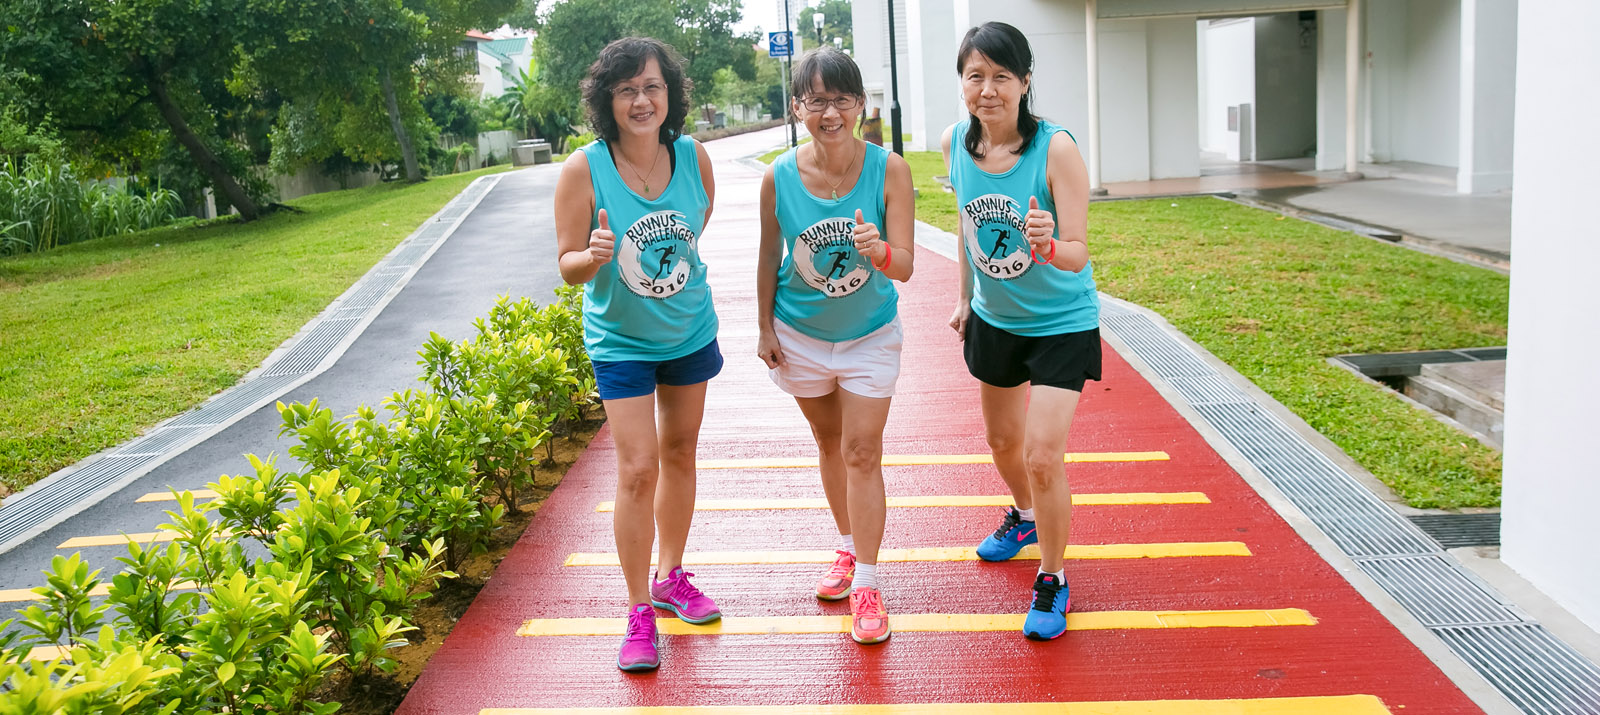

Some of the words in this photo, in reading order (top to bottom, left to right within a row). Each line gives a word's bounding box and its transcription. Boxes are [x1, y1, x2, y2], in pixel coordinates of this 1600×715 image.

[965, 198, 1011, 217] RUNNUS
[626, 214, 676, 242] RUNNUS
[800, 221, 852, 244] RUNNUS
[636, 228, 694, 252] CHALLENGER
[809, 234, 856, 254] CHALLEN
[978, 255, 1023, 274] 2016
[639, 272, 685, 294] 2016
[813, 277, 861, 293] 2016
